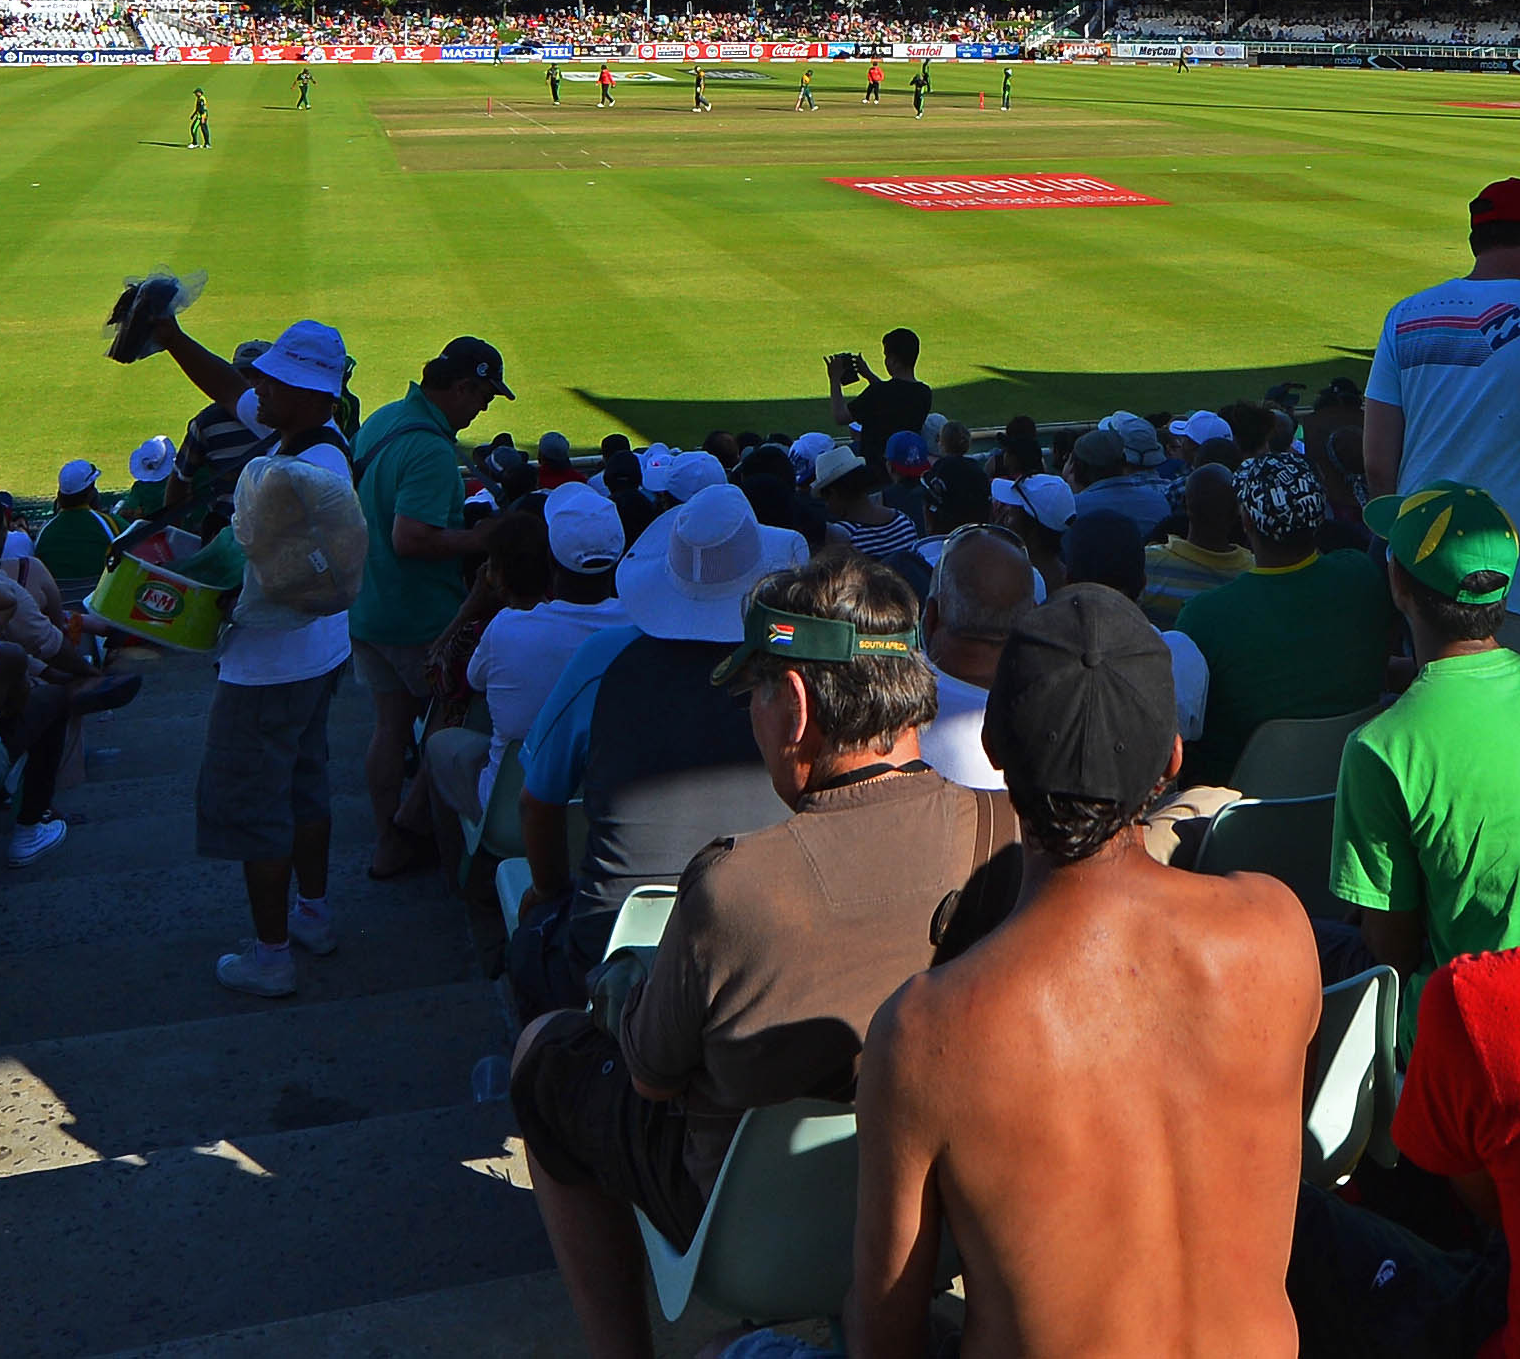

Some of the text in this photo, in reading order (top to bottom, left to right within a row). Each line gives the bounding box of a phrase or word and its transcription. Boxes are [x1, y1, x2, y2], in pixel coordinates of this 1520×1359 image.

[537, 47, 572, 57] STEEL
[906, 44, 942, 57] Sunfoil
[1139, 45, 1177, 57] MeyCom
[18, 51, 78, 64] Investec
[95, 51, 153, 63] Investec
[1334, 55, 1362, 65] mobile
[1480, 59, 1507, 70] mobile
[855, 178, 1115, 195] momentum
[859, 640, 884, 650] SOUTH
